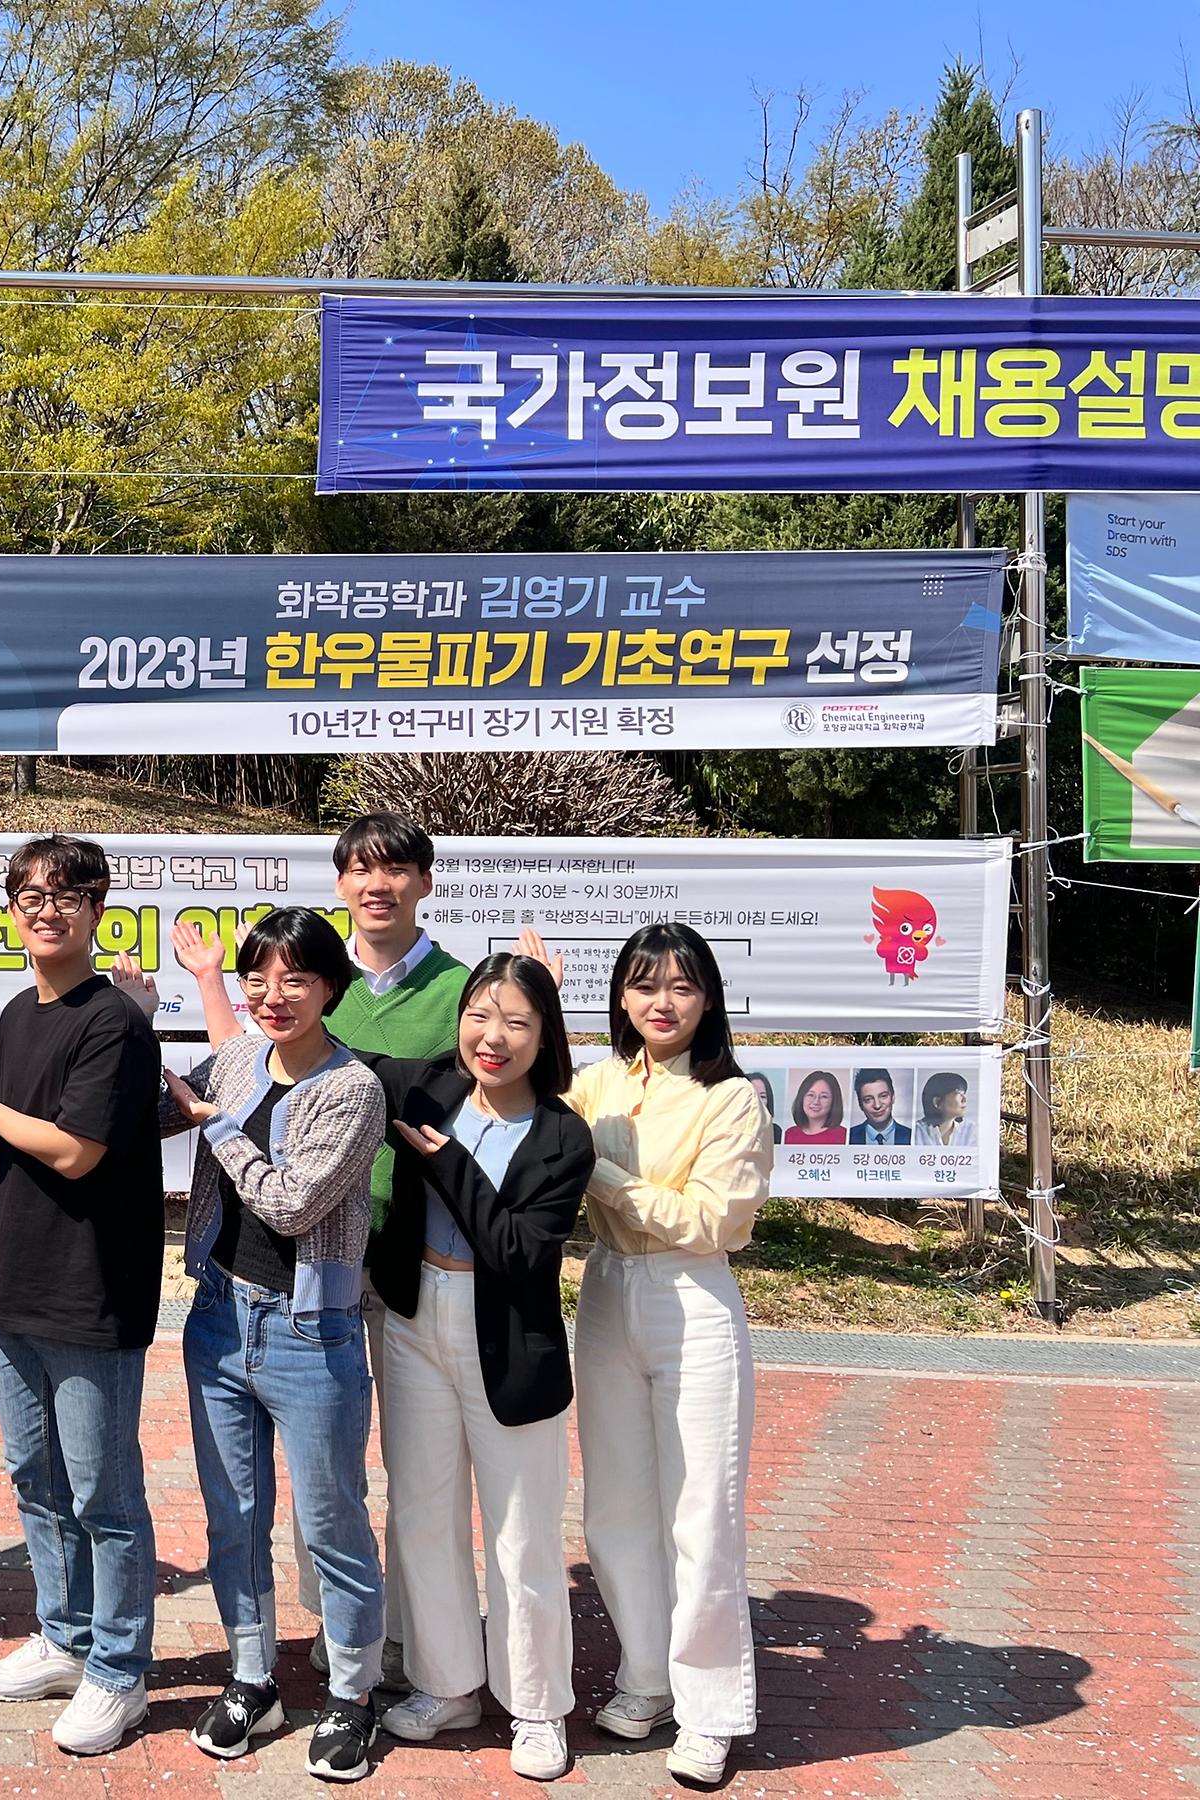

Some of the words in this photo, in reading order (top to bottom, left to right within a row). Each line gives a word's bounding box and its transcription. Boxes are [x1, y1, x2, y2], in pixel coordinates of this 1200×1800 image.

[417, 349, 861, 441] 국가정보원
[1107, 513, 1137, 527] Start
[1138, 519, 1166, 531] your
[1107, 529, 1147, 544] Dream
[1150, 534, 1177, 547] with
[1106, 545, 1128, 558] SDS
[276, 580, 468, 619] 화학공학과
[480, 575, 607, 618] 김영기
[620, 575, 707, 618] 교수
[78, 636, 248, 689] 2023년
[265, 630, 549, 689] 한우물파기
[561, 629, 791, 687] 기초연구
[805, 630, 913, 684] 선정
[288, 709, 381, 739] 10년간
[388, 708, 474, 738] 연구비
[483, 708, 541, 737] 장기
[550, 707, 608, 737] 지원
[616, 706, 675, 736] 확정
[821, 713, 866, 722] Chemical
[869, 712, 925, 723] Engineering
[435, 858, 460, 873] 3월
[465, 858, 551, 874] 13일(월)부터
[557, 859, 635, 874] 시작합니다!
[170, 857, 237, 890] 먹고
[243, 857, 288, 891] 가!
[435, 884, 464, 899] 매일
[469, 884, 499, 898] 아침
[503, 884, 527, 899] 7시
[531, 884, 567, 898] 30분
[584, 884, 609, 899] 9시
[614, 884, 679, 899] 30분까지
[434, 909, 516, 924] 해동-아우름
[521, 909, 535, 924] 홀
[673, 910, 732, 925] 든든하게
[737, 910, 766, 925] 아침
[770, 911, 819, 926] 드세요!
[788, 1153, 806, 1166] 4강
[809, 1154, 841, 1166] 05/25
[853, 1153, 870, 1166] 5강
[873, 1154, 906, 1166] 06/08
[919, 1154, 936, 1167] 6강
[940, 1155, 972, 1167] 06/22
[797, 1168, 831, 1182] 오혜선
[856, 1169, 901, 1182] 마크테토
[934, 1169, 957, 1182] 한강
